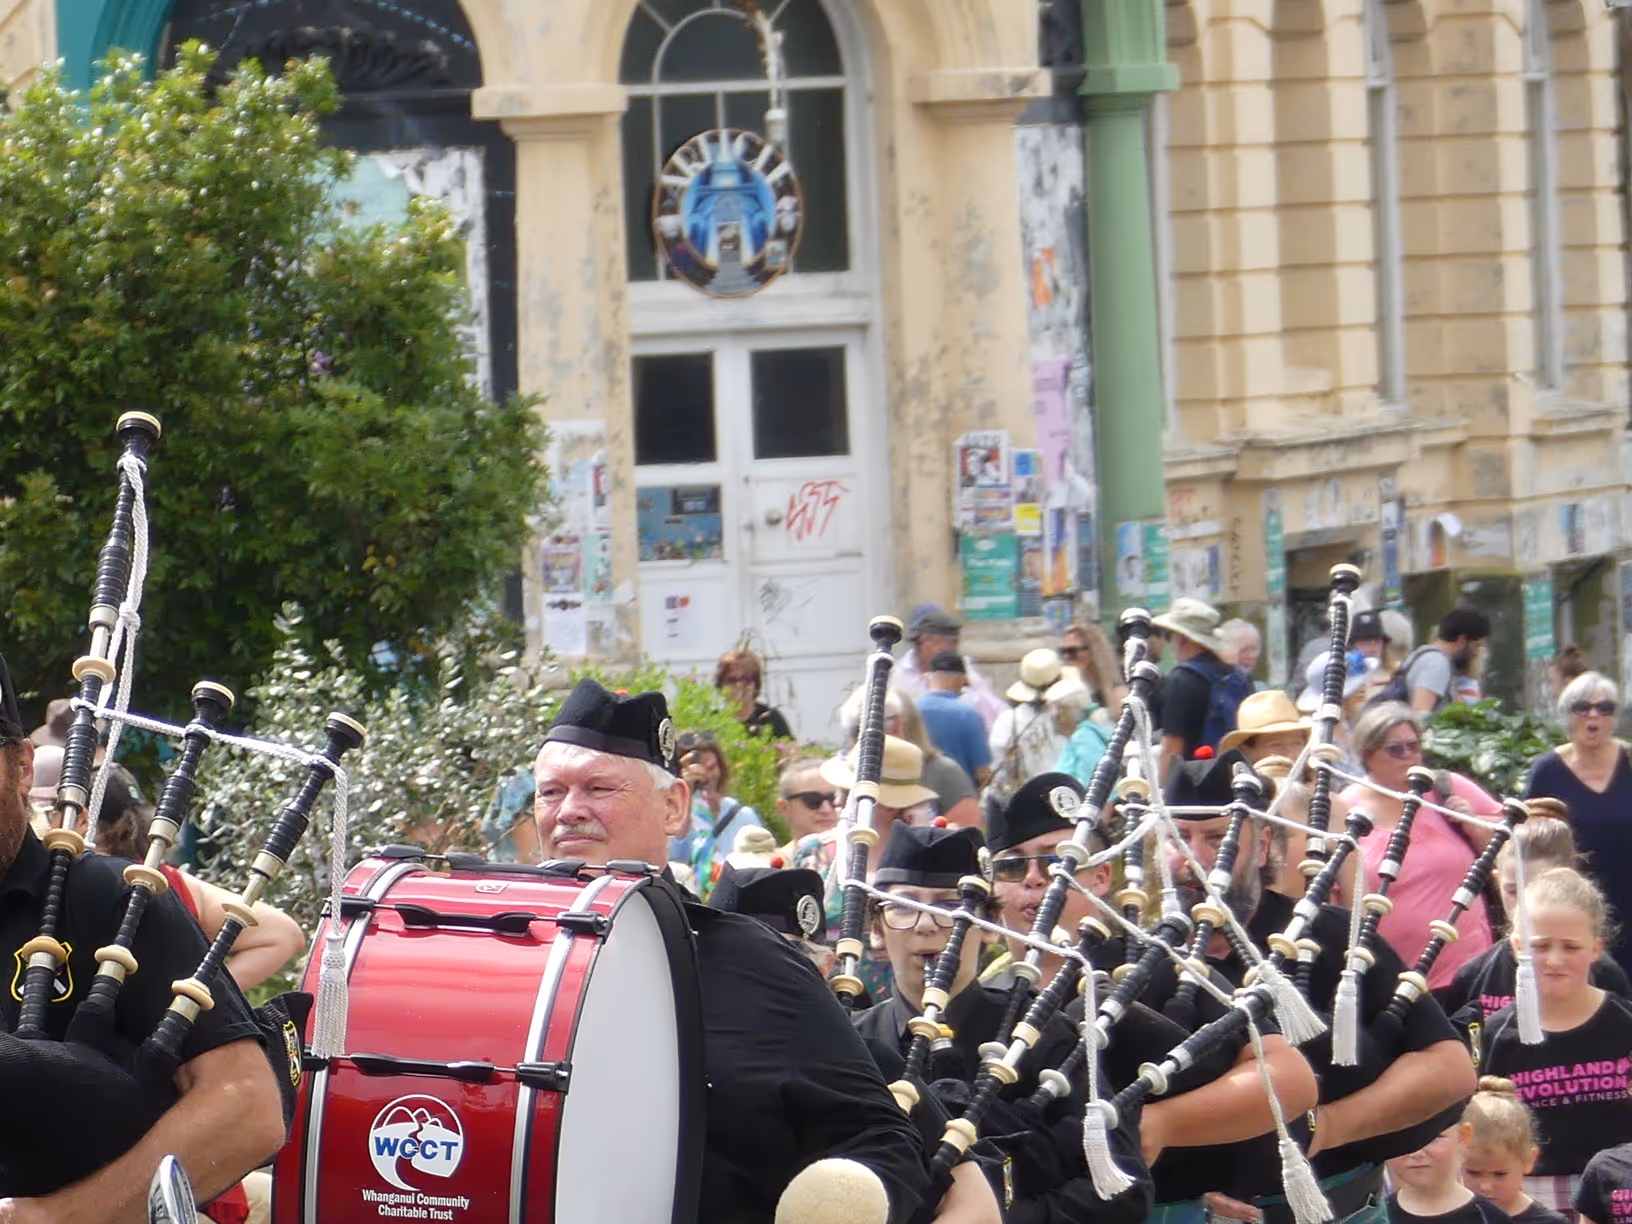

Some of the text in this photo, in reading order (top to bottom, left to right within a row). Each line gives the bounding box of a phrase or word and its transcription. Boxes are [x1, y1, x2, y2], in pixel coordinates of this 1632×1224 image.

[1509, 1060, 1615, 1085] HIGHLAND
[1514, 1075, 1627, 1100] EVOLUTION
[1530, 1097, 1557, 1108] NCE
[1575, 1090, 1628, 1103] FITNESS
[374, 1136, 459, 1161] WCCT
[362, 1189, 470, 1210] Whanganui Community
[378, 1204, 453, 1221] Charitable Trust
